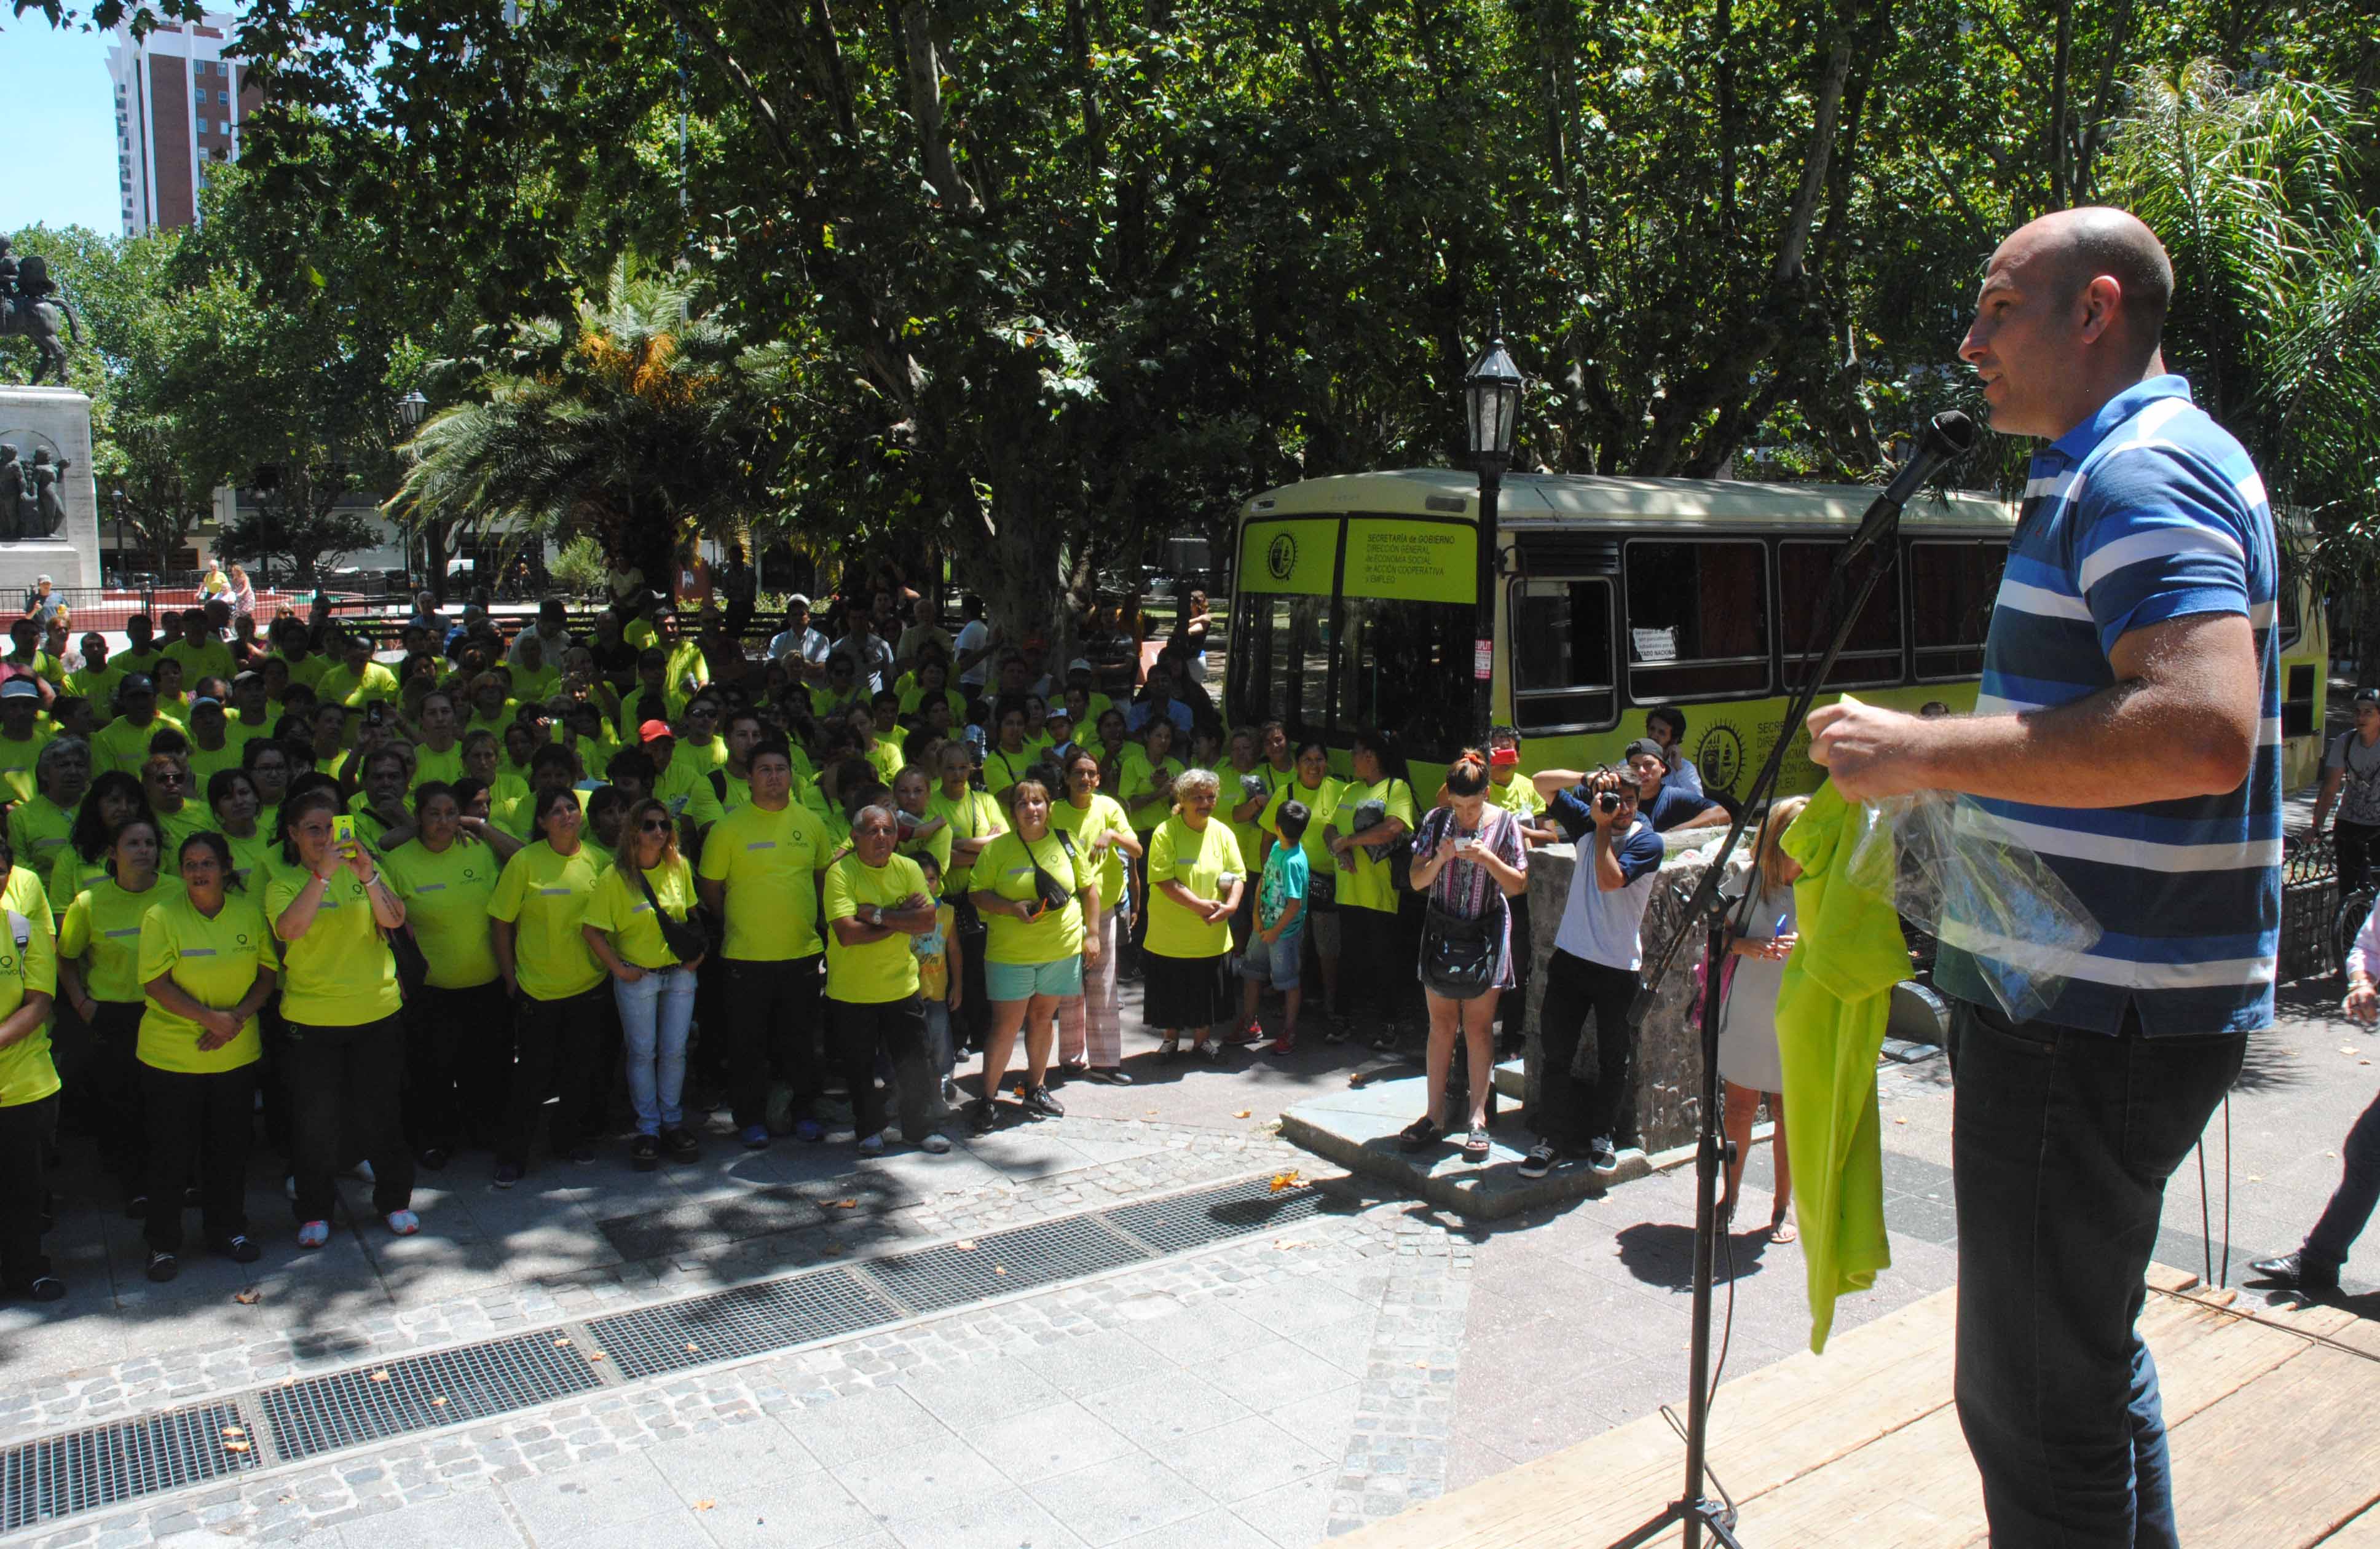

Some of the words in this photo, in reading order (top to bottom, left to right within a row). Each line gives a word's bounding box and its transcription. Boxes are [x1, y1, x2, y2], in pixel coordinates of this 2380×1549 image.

[1367, 533, 1408, 542] SECRETARÍA
[1418, 535, 1456, 544] GOBIERNO
[1401, 545, 1430, 554] GENERAL
[1408, 556, 1432, 565] SOCIAL
[1397, 566, 1444, 576] COOPERATIVA
